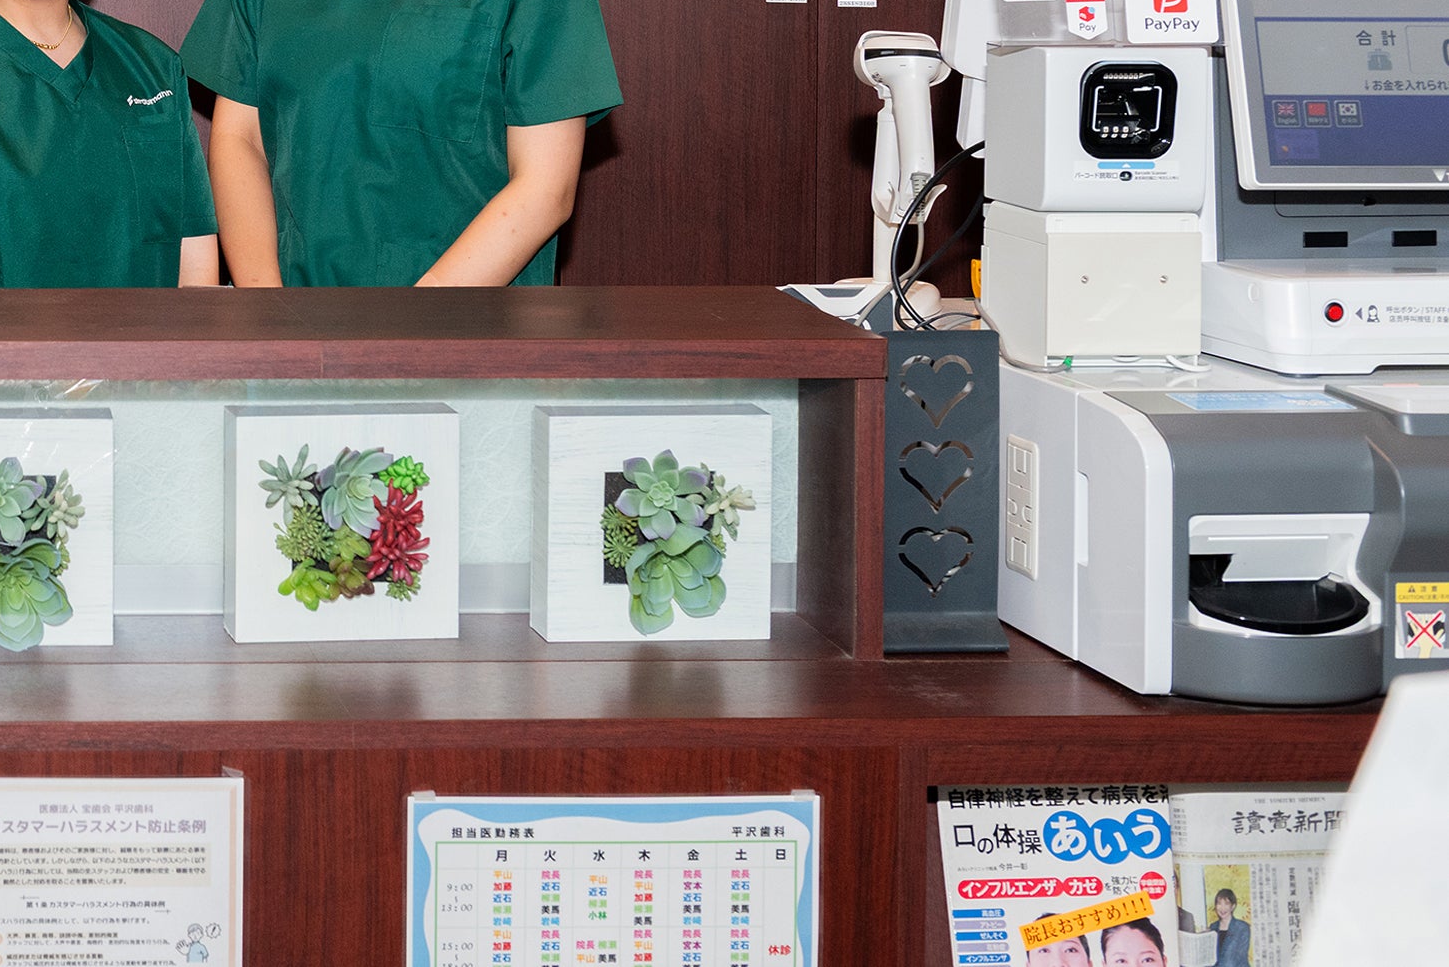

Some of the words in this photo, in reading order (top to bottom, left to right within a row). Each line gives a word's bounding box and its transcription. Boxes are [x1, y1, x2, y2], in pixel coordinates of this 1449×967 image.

[1079, 23, 1096, 32] Pay
[1145, 17, 1200, 32] PayPay
[1356, 30, 1396, 46] 合計
[1372, 80, 1449, 91] お金を入れられ
[39, 804, 78, 814] 医療法人
[82, 804, 111, 814] 宝歯会
[115, 804, 154, 814] 平沢歯科
[451, 828, 534, 839] 担当医勤務表
[732, 826, 785, 837] 平沢歯科
[953, 823, 1042, 855] 口の体操
[1049, 814, 1162, 857] あいう
[496, 850, 508, 861] 月
[544, 850, 556, 861] 火
[593, 850, 605, 861] 水
[639, 849, 650, 861] 木
[688, 849, 700, 861] 金
[735, 849, 747, 861] 土
[776, 849, 786, 860] 日
[493, 871, 512, 879] 平山
[541, 871, 560, 879] 院長
[634, 870, 653, 878] 院長
[589, 875, 607, 884] 平山
[1111, 876, 1138, 885] 強力に
[541, 882, 560, 891] 近石
[683, 882, 702, 890] 宮本
[731, 882, 750, 890] 近石
[962, 880, 1056, 897] インフルエンザ
[1069, 879, 1098, 894] カゼ
[1105, 883, 1112, 891] を
[541, 906, 560, 914] 美馬
[683, 905, 701, 913] 美馬
[589, 911, 607, 920] 小林
[980, 932, 1003, 940] ぜんそく
[768, 945, 791, 955] 休診
[966, 955, 1008, 963] インフルエンザ
